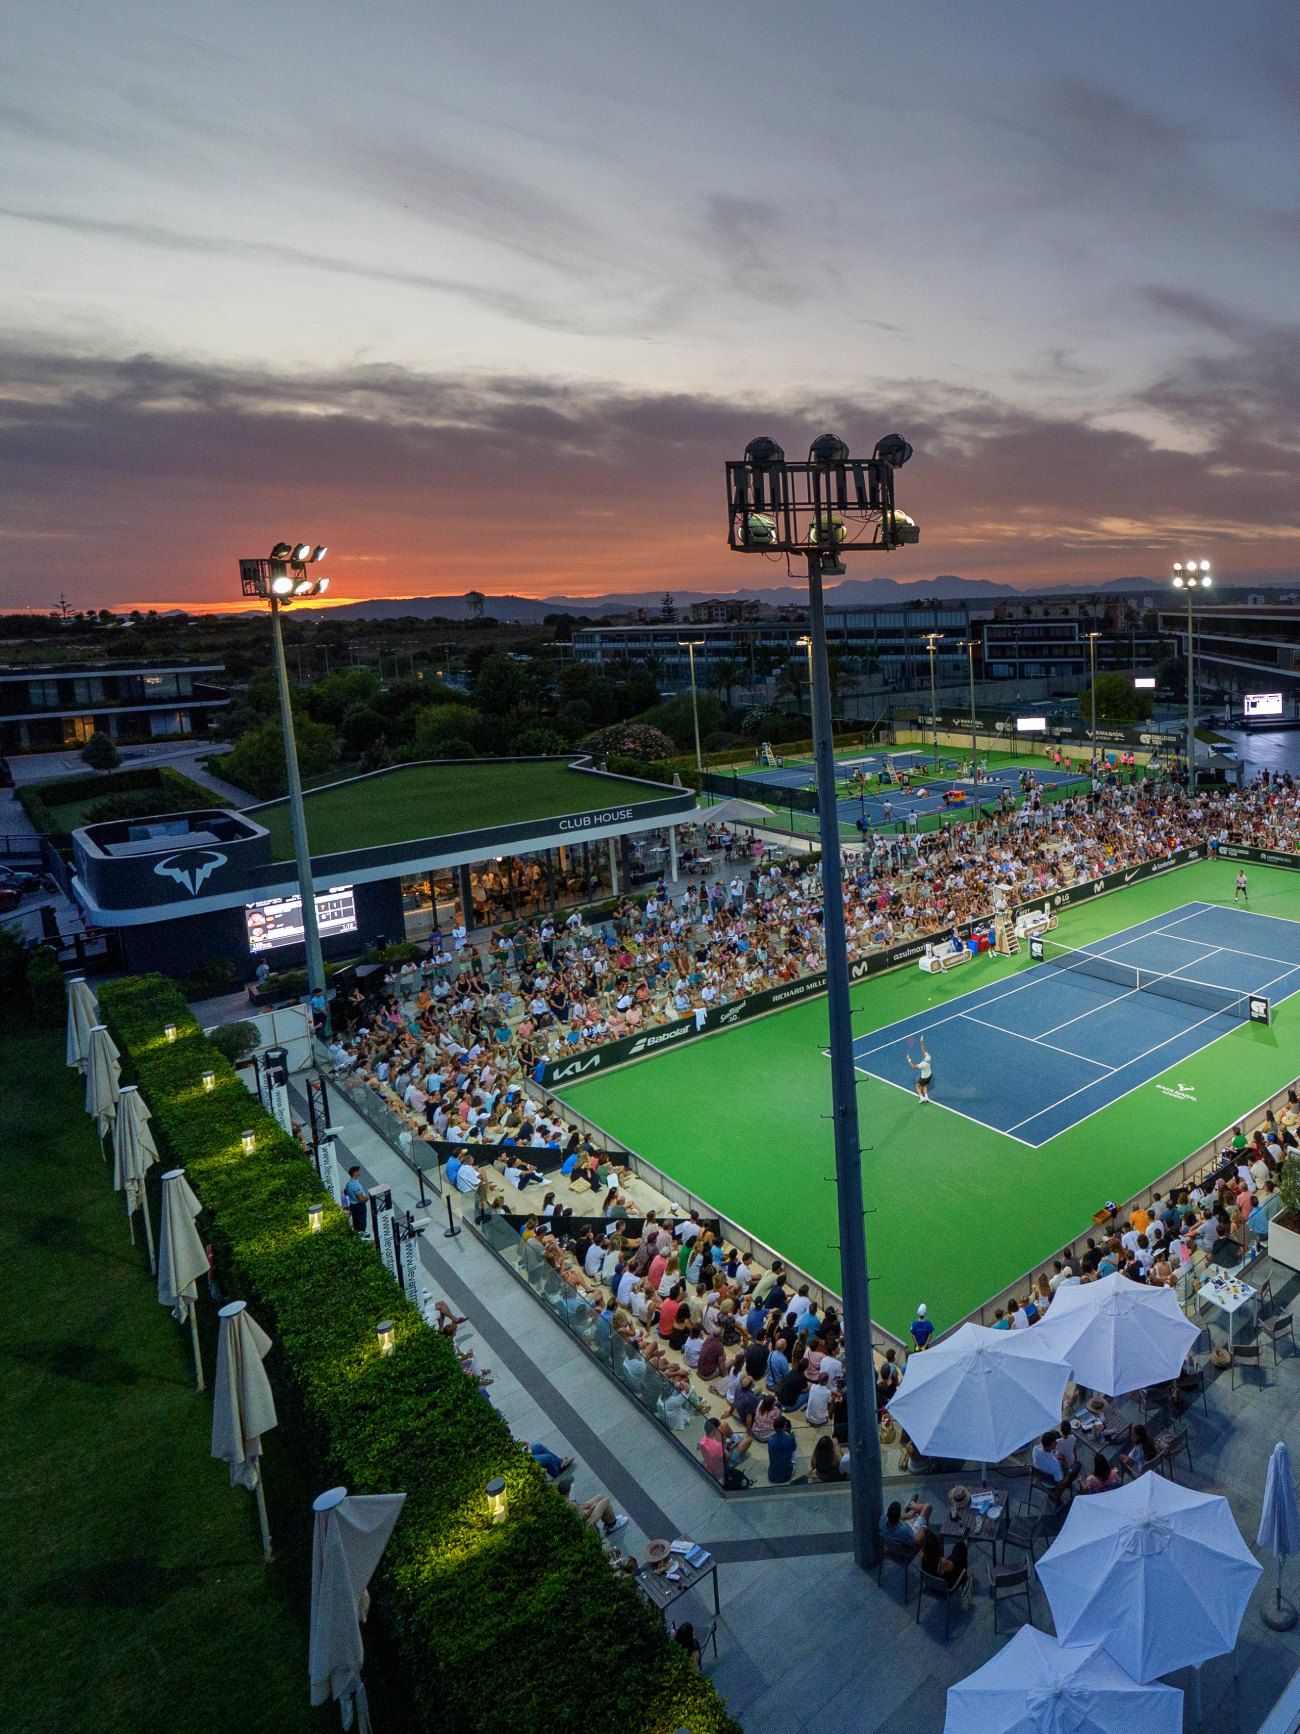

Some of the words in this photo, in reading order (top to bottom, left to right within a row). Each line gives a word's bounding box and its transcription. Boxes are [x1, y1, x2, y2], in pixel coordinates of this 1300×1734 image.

[559, 816, 591, 830] CLUB
[594, 809, 633, 824] HOUSE
[1062, 894, 1070, 902] LG
[772, 986, 804, 1002] RICHARD
[805, 979, 827, 990] MILLE
[646, 1024, 690, 1046] Babolat
[553, 1054, 600, 1080] KIA
[404, 1240, 418, 1304] www.llevantm
